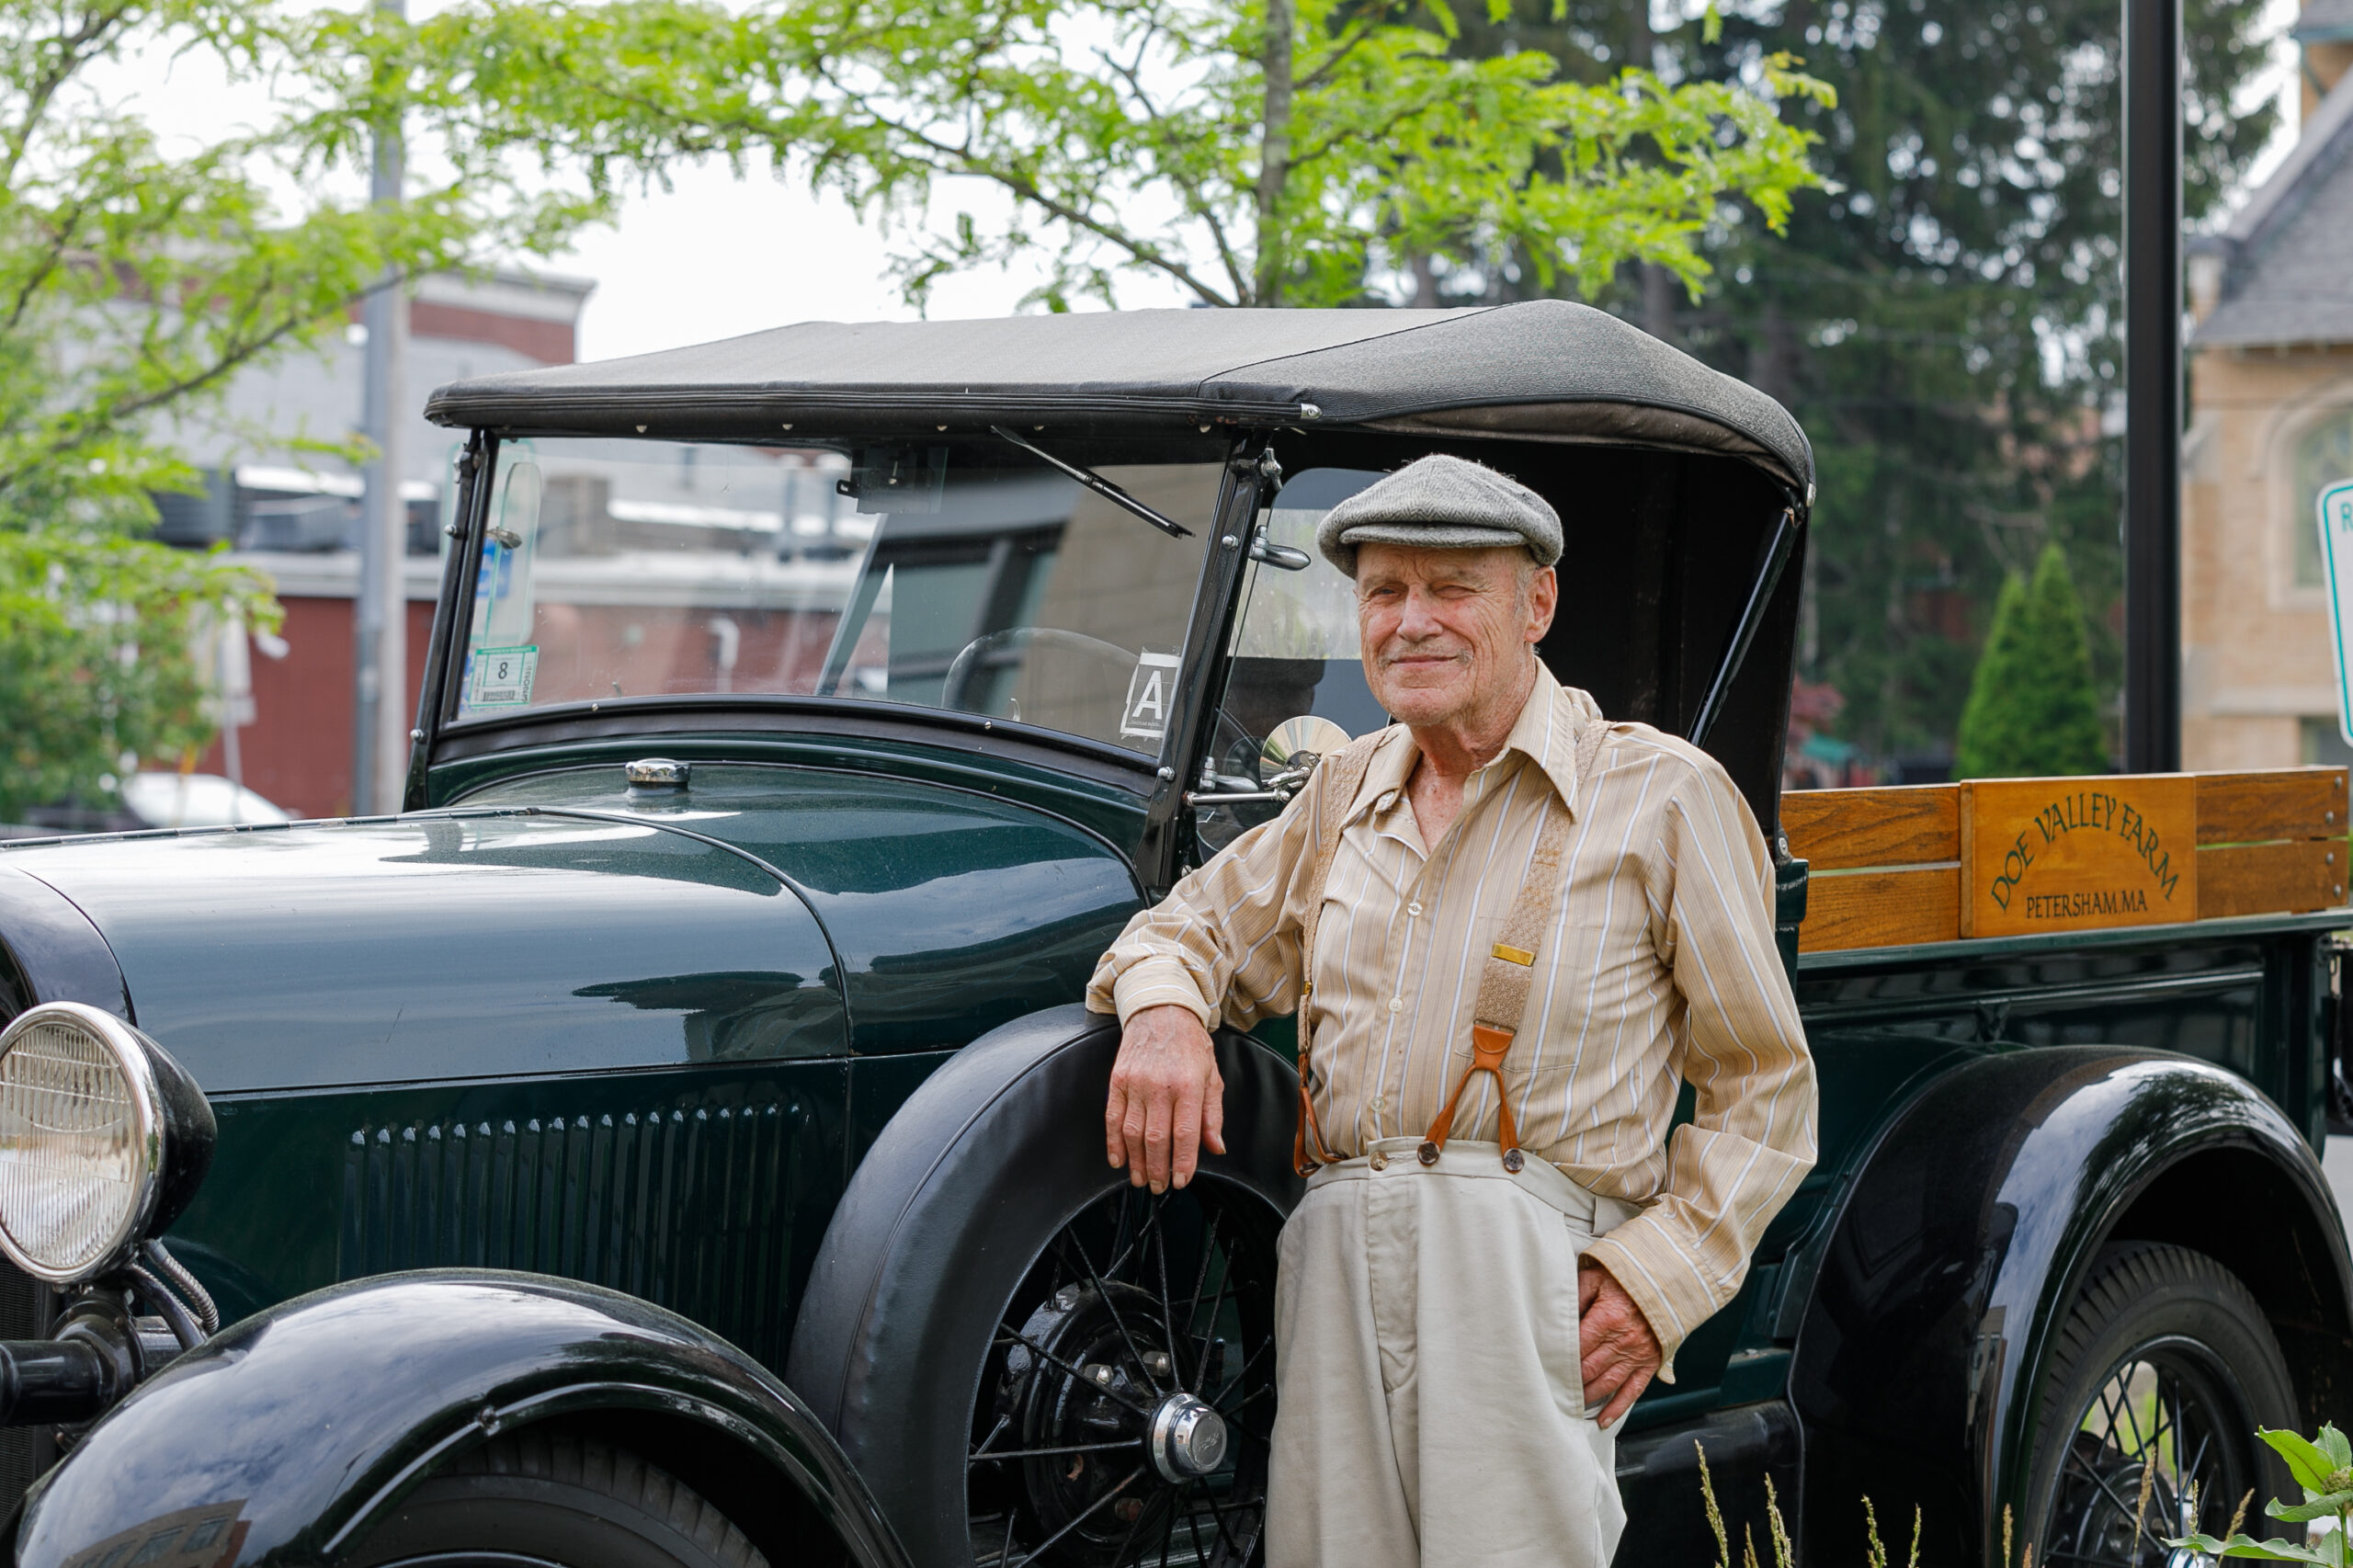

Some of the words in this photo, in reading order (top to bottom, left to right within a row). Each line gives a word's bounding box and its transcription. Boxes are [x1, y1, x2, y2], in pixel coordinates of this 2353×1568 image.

[498, 662, 508, 679] 8
[1132, 670, 1162, 720] A
[1991, 831, 2035, 913] DOE
[2034, 793, 2117, 844] VALLEY
[2120, 803, 2179, 903] FARM
